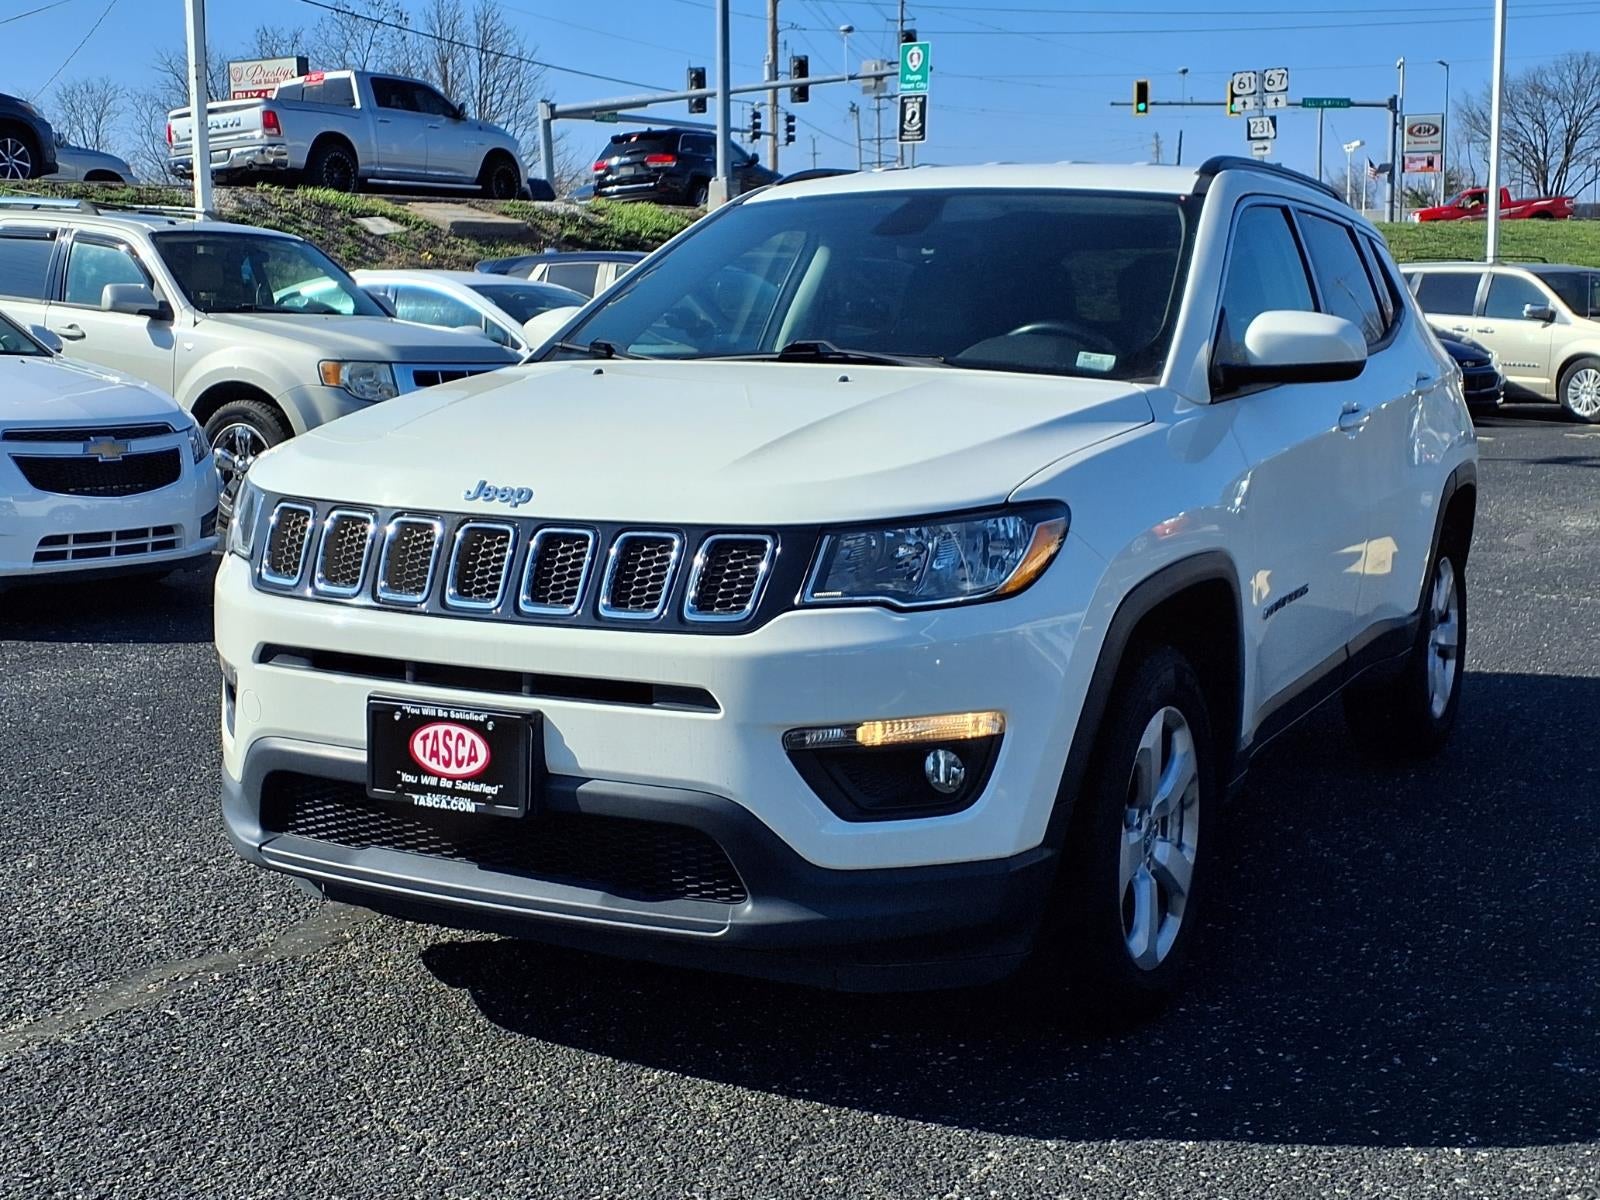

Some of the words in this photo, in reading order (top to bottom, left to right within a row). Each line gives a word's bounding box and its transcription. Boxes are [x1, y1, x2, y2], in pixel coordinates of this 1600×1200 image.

[246, 64, 295, 81] Prestige
[1267, 73, 1285, 86] 67
[1238, 77, 1252, 89] 61
[1251, 121, 1270, 134] 231
[464, 479, 533, 508] Jeep
[402, 705, 420, 715] "You
[421, 707, 436, 716] Will
[437, 709, 448, 718] Be
[449, 710, 488, 721] Satisfied"
[419, 728, 479, 769] TASCA
[396, 770, 418, 783] "You
[420, 775, 438, 787] Will
[439, 778, 453, 788] Be
[454, 780, 503, 795] Satisfied"
[412, 794, 476, 813] TASCA.COM
